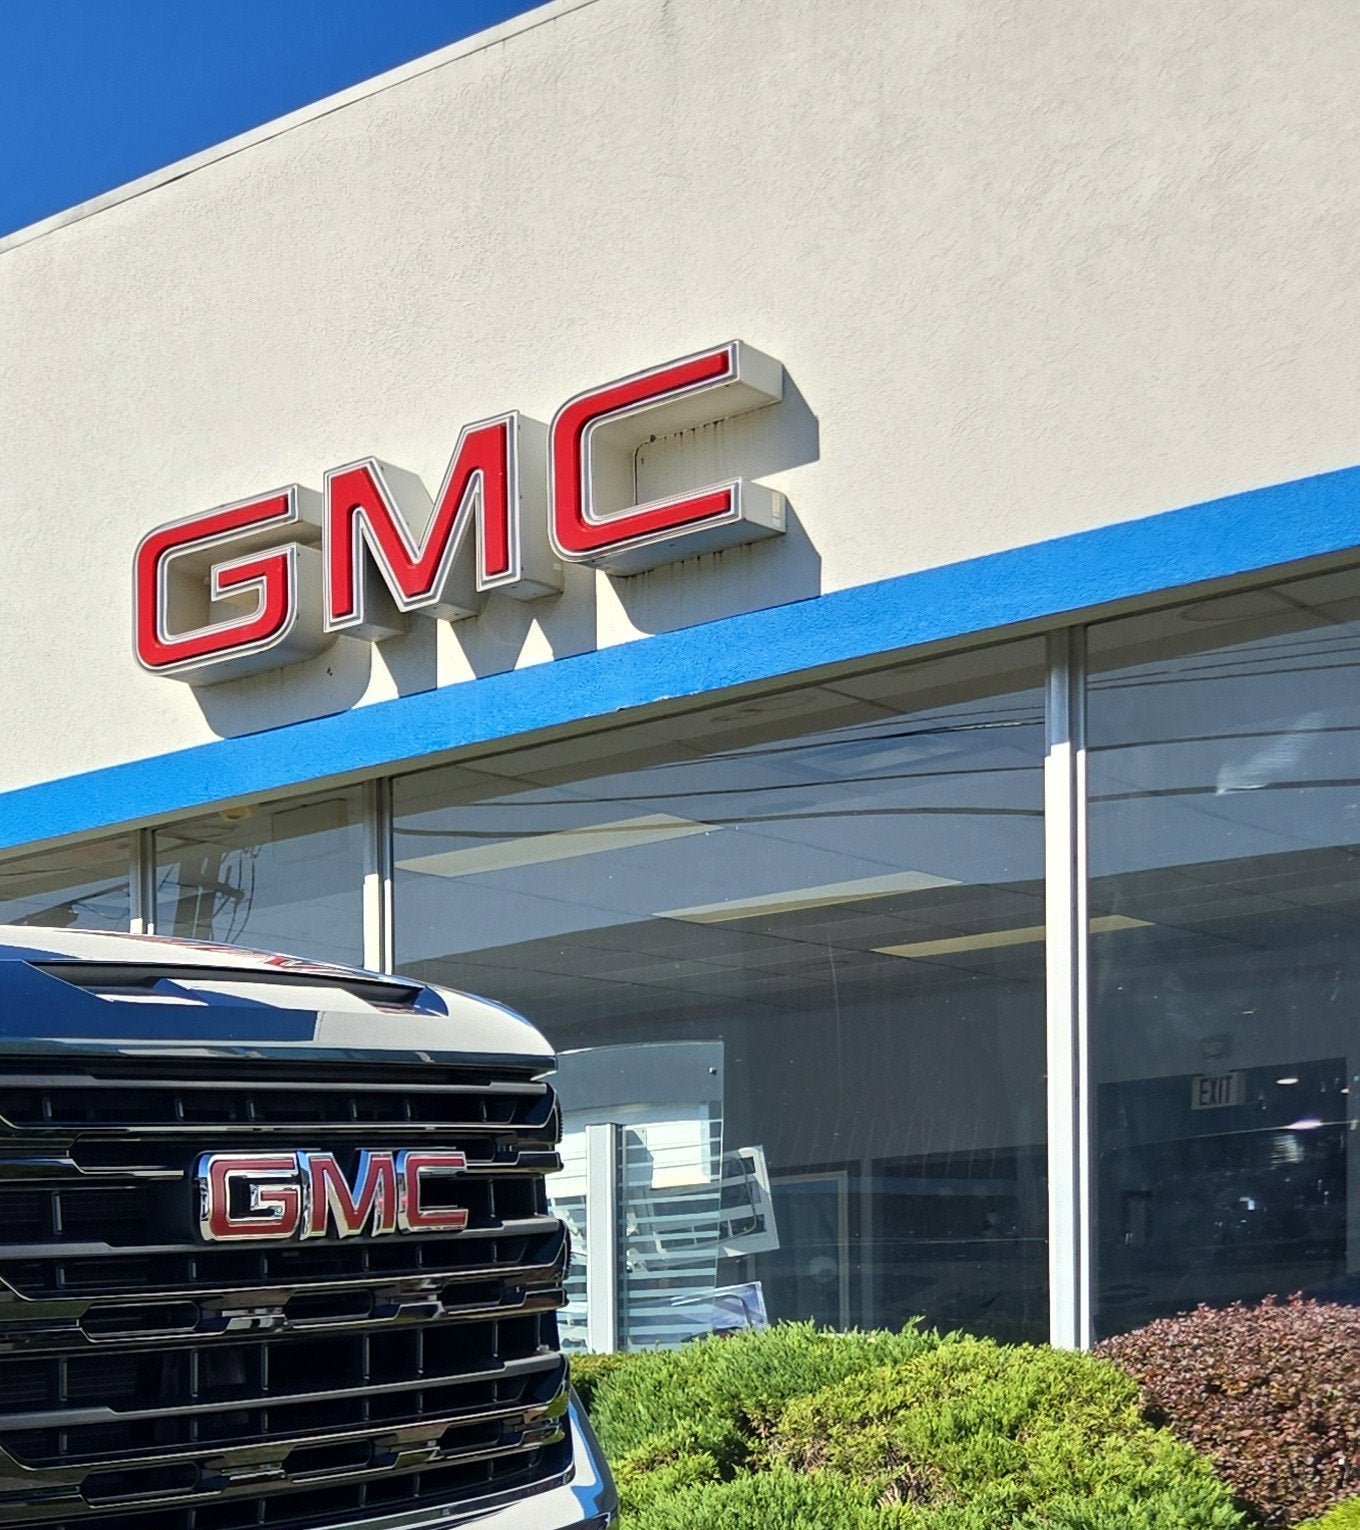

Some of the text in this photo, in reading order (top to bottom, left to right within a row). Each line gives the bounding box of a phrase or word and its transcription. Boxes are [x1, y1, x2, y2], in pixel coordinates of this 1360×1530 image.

[132, 339, 745, 677] GMC
[1199, 1076, 1233, 1106] EXIT
[198, 1150, 469, 1241] GMC
